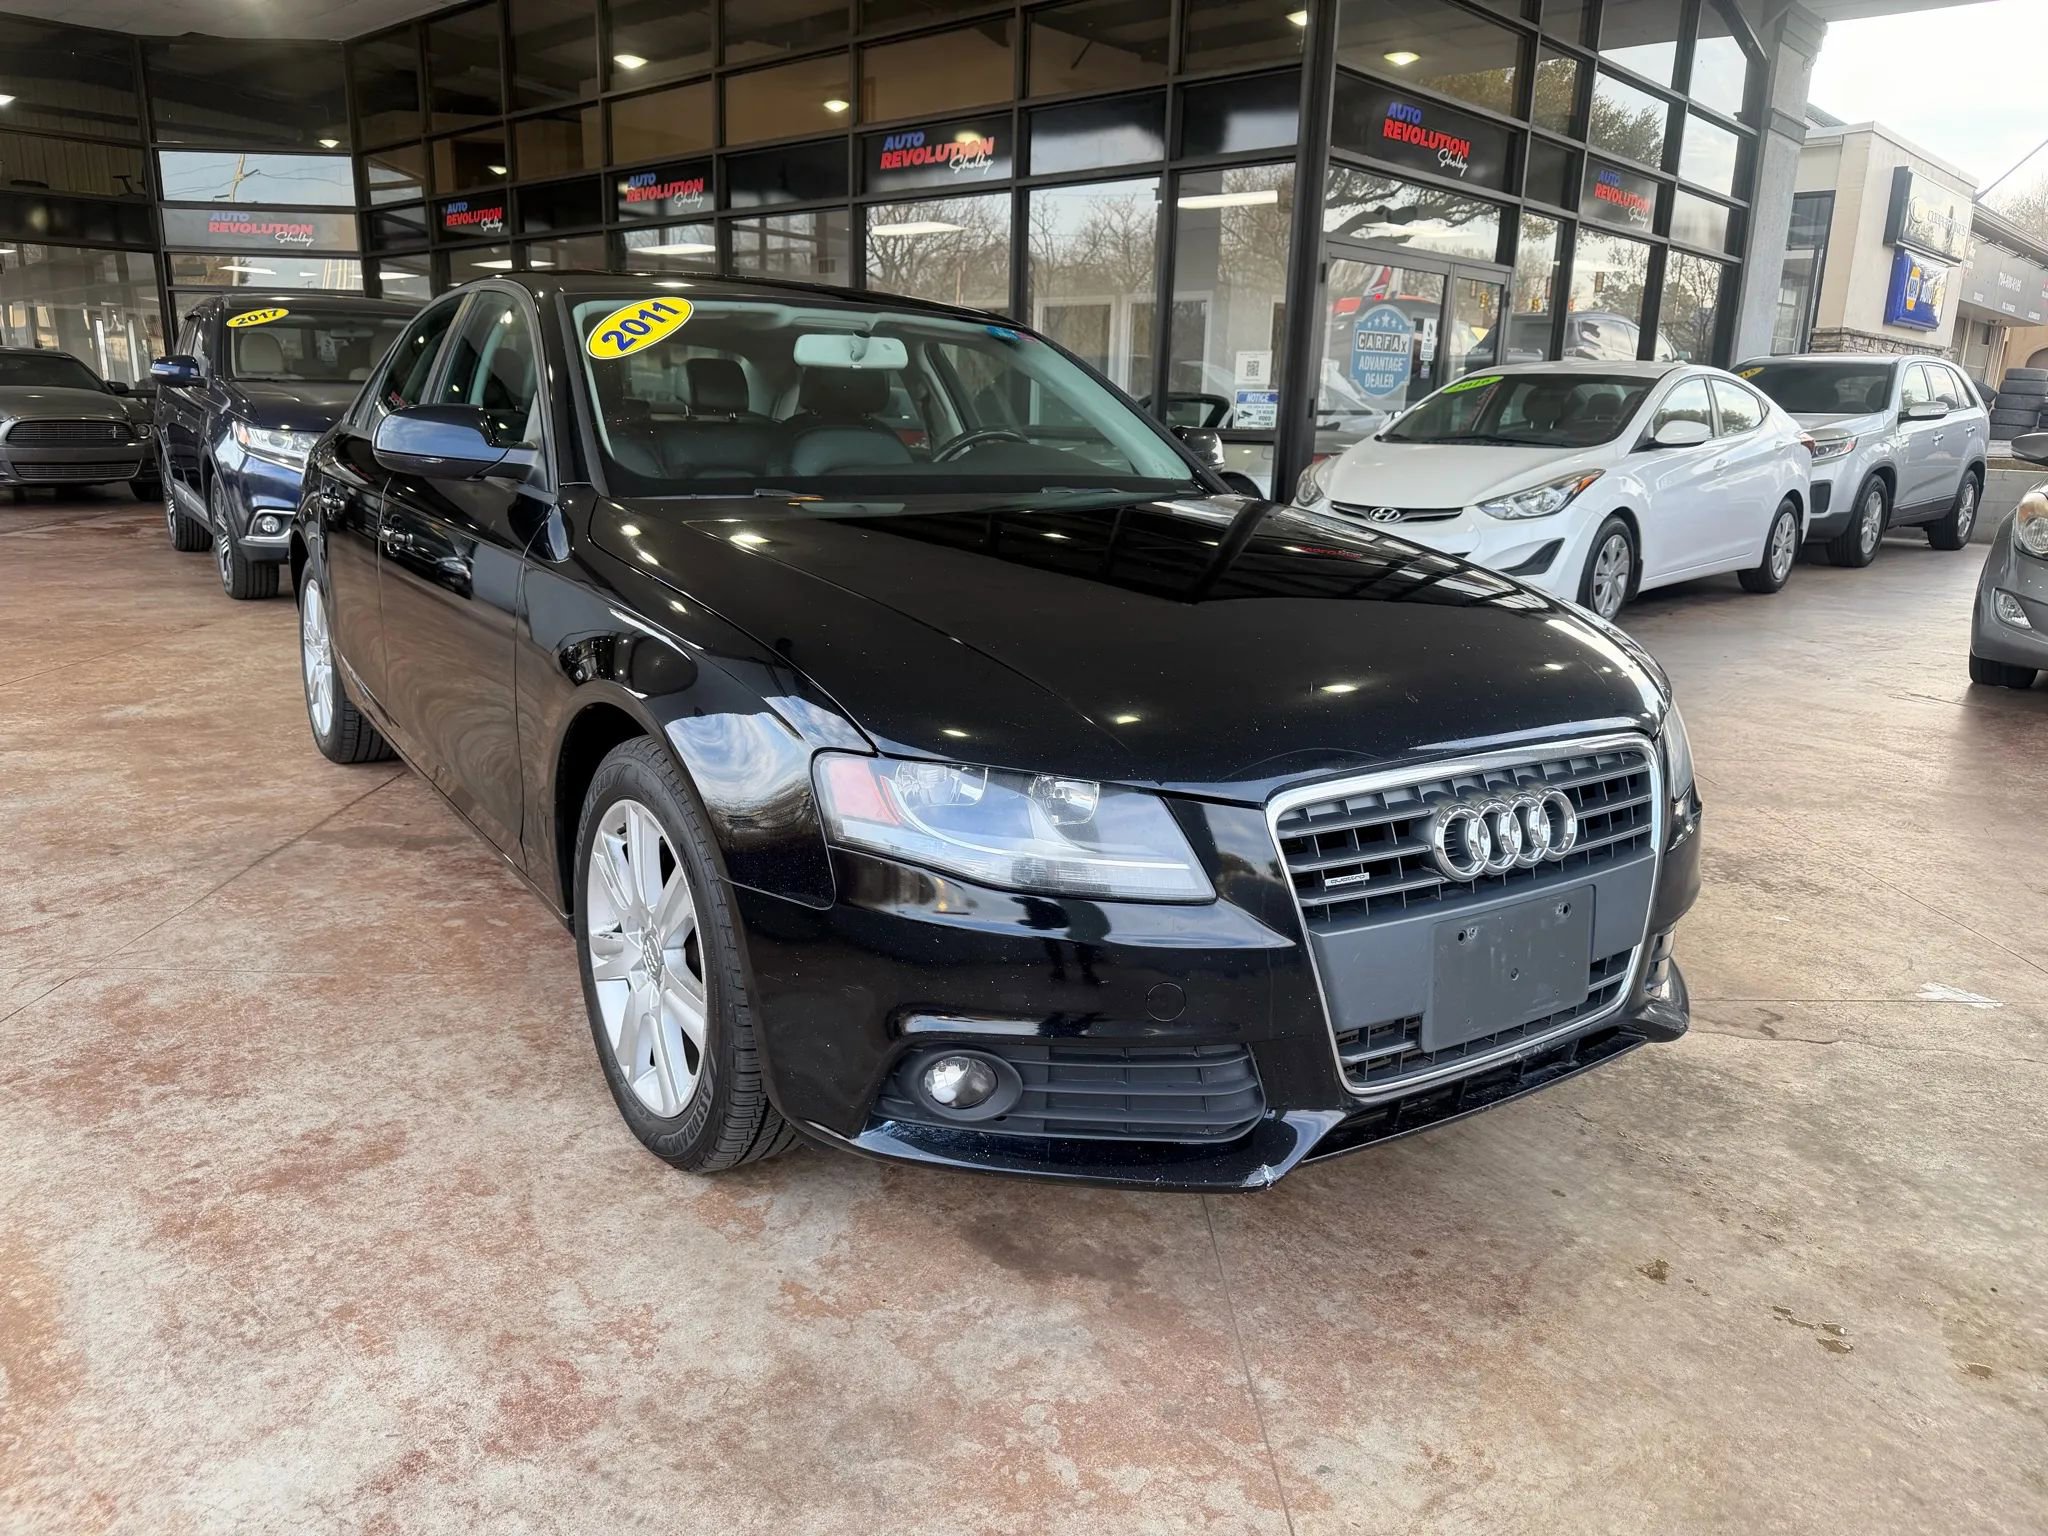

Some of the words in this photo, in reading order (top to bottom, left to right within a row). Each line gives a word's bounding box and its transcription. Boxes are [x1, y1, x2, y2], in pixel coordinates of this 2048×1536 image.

[1387, 102, 1422, 124] AUTO
[883, 131, 925, 151] AUTO
[1383, 118, 1470, 158] REVOLUTION
[880, 136, 995, 169] REVOLUTION
[949, 152, 994, 174] Shelby
[1437, 148, 1468, 177] Shelby
[628, 172, 656, 187] AUTO
[1599, 170, 1621, 187] AUTO
[626, 178, 704, 203] REVOLUTION
[673, 189, 704, 208] Shelby
[1594, 182, 1651, 213] REVOLUTION
[210, 212, 250, 222] AUTO
[446, 207, 502, 227] REVOLUTION
[447, 201, 468, 214] AUTO
[208, 222, 314, 235] REVOLUTION
[274, 232, 314, 247] Shelby
[235, 310, 278, 325] 2017
[601, 301, 681, 352] 2011
[1358, 332, 1408, 353] CARFAX
[1358, 356, 1404, 372] ADVANTAGE
[1364, 373, 1394, 388] DEALER
[1246, 392, 1269, 403] NOTICE
[1331, 874, 1366, 884] quattro
